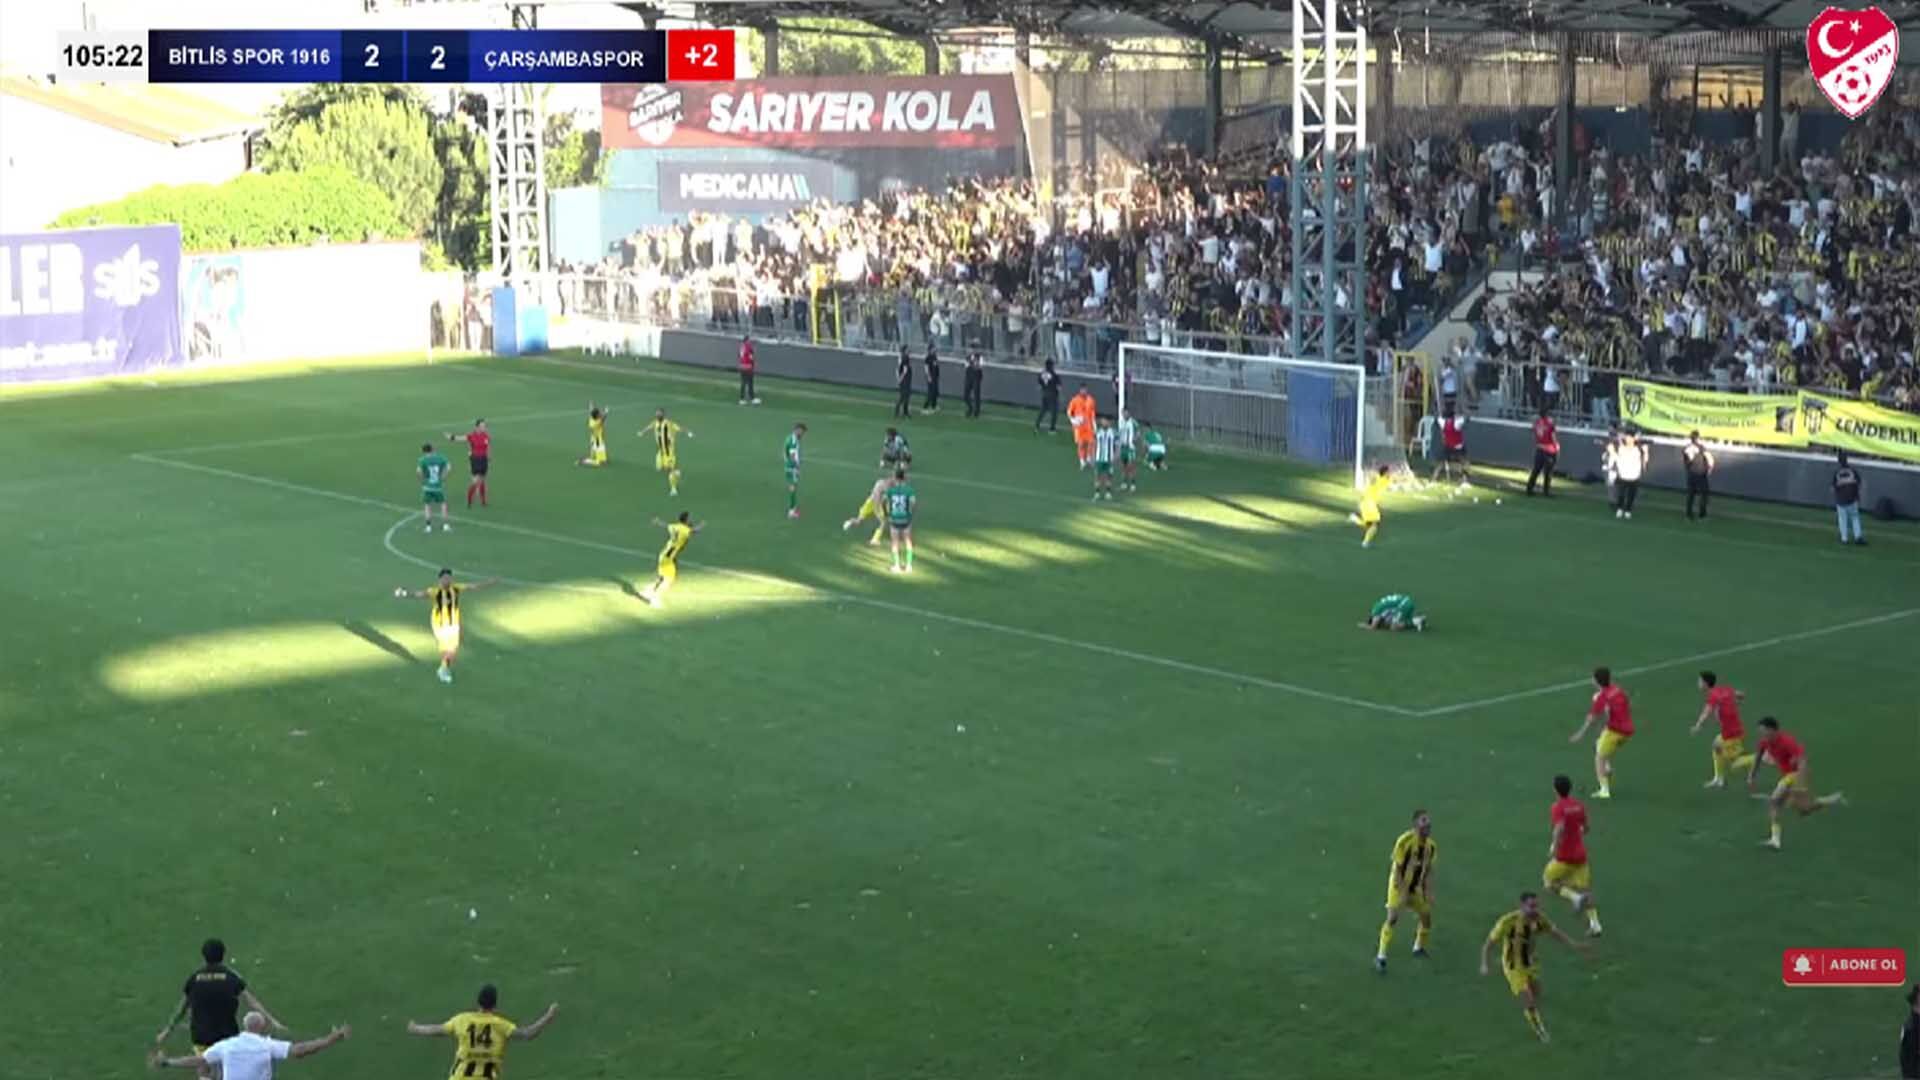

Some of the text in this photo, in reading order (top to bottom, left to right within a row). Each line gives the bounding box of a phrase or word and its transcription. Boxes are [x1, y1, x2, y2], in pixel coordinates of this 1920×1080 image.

[707, 89, 995, 132] SARIYER KOLA
[680, 172, 797, 200] MEDICANA
[466, 1021, 493, 1050] 14
